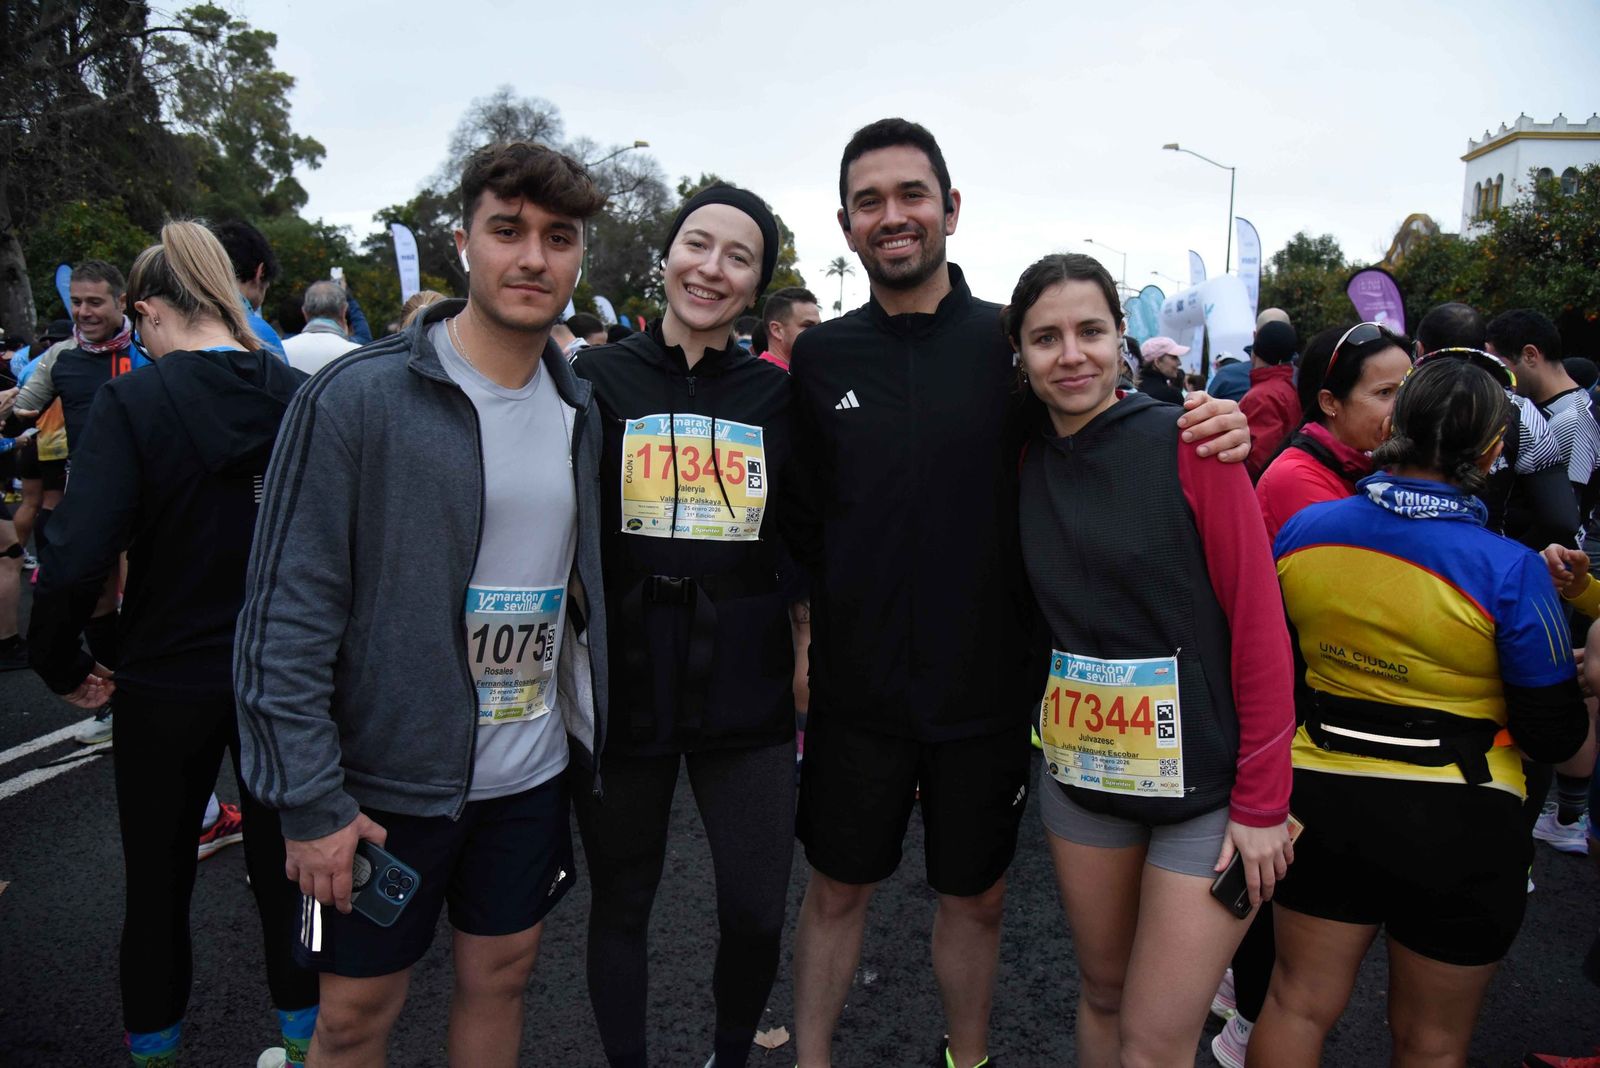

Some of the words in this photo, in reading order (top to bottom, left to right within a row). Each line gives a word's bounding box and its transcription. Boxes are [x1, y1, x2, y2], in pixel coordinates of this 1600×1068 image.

[685, 426, 720, 439] sevila
[637, 443, 746, 485] 17345
[660, 495, 688, 504] Valeyia
[493, 591, 539, 603] maratón
[503, 599, 538, 612] sevilla
[472, 623, 549, 664] 1075
[1319, 641, 1347, 657] UNA
[1352, 651, 1409, 674] CIUDAD
[484, 666, 514, 676] Rosales
[1077, 661, 1124, 675] maratón
[1363, 666, 1409, 683] CAMINOS
[1086, 671, 1124, 684] sevilla
[1050, 686, 1155, 736] 17344
[1078, 733, 1115, 746] Julvazesc
[1061, 742, 1077, 751] Julia
[1107, 749, 1140, 759] Escobar
[1080, 774, 1100, 784] HOKA
